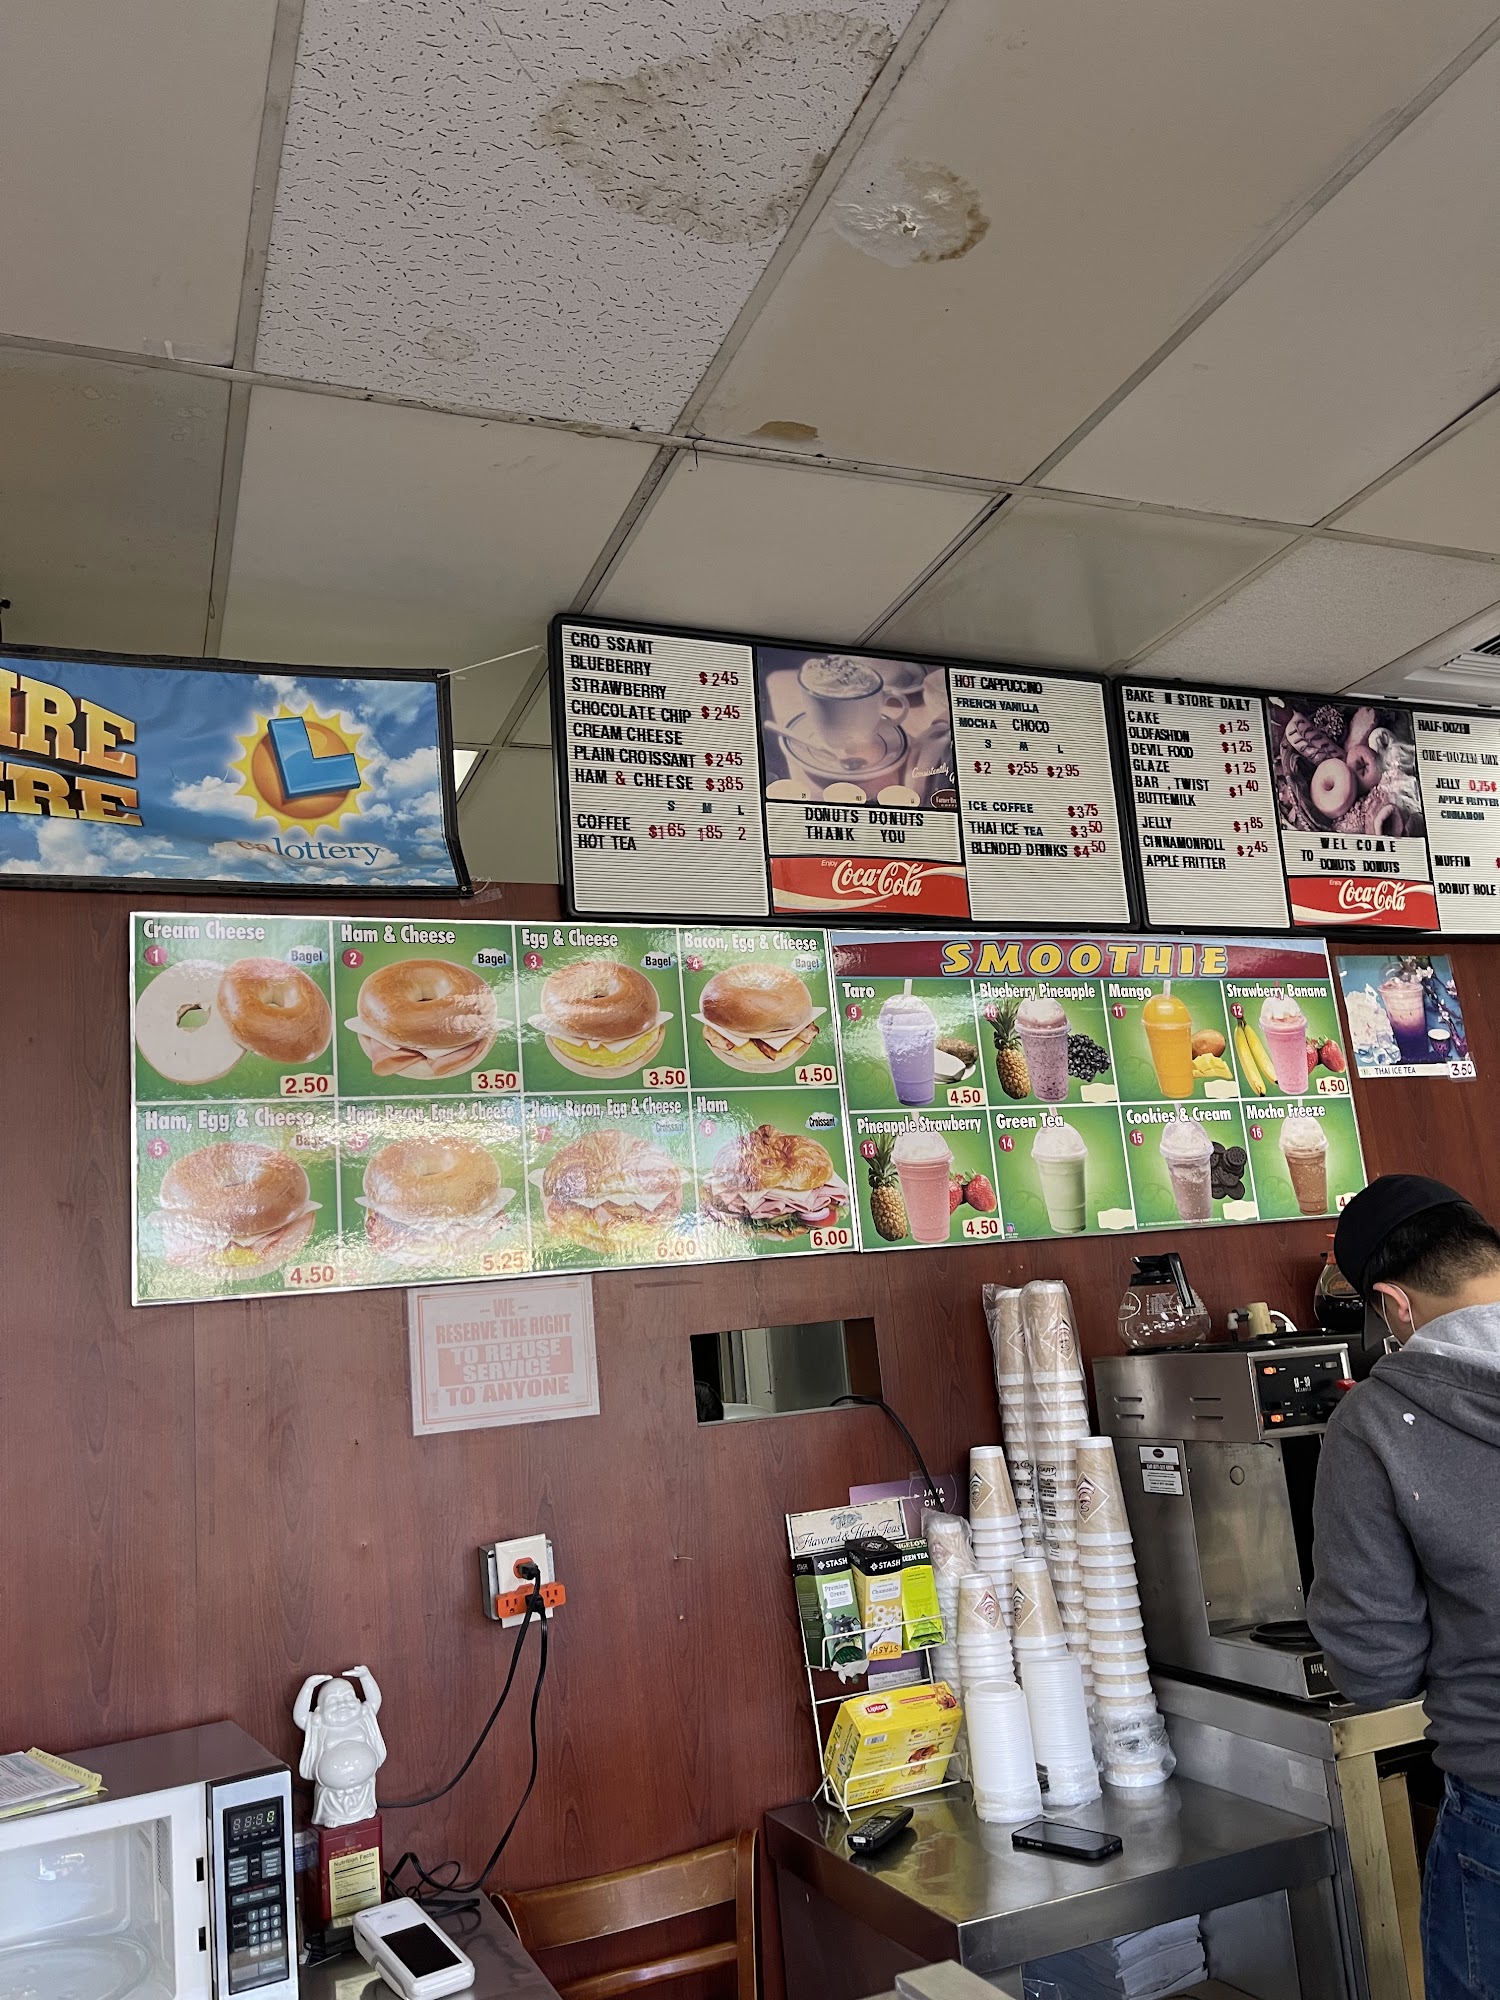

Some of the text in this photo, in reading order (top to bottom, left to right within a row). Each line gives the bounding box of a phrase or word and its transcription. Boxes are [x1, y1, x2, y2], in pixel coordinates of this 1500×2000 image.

[570, 632, 654, 655] CRO SSANT
[570, 655, 652, 677] BLUEBERRY
[571, 677, 667, 700] STRAWBERRY
[955, 675, 1043, 695] HOT CAPPUCCINO
[956, 697, 1040, 714] FRENCH VANILLA
[1125, 689, 1154, 703] BAKE
[1178, 693, 1214, 708] STORE
[1220, 697, 1251, 711] DAILY
[571, 700, 692, 724] CHOCOLATE CHIP
[1127, 711, 1160, 724] CAKE
[959, 717, 1050, 733] MOCHA CHOCO
[1418, 720, 1470, 734] HALF-DOZEN
[572, 723, 683, 746] CREAM CHEESE
[1128, 727, 1190, 742] OLDFASHION
[573, 745, 696, 768] PLAIN CROISSANT
[1131, 743, 1194, 759] DEVIL FOOD
[1133, 759, 1170, 773] GLAZE
[575, 768, 694, 791] HAM & CHEESE
[968, 800, 988, 811] ICE
[992, 801, 1034, 813] COFFEE
[1138, 792, 1196, 806] BUTTEMILK
[577, 814, 631, 832] COFFEE
[805, 807, 924, 827] DONUTS DONUTS
[1142, 816, 1172, 829] JELLY
[1440, 810, 1485, 820] CINNAMON
[805, 826, 906, 844] THANK YOU
[968, 821, 1043, 837] THAI ICE TEA
[578, 834, 637, 851] HOT TEA
[971, 841, 1068, 857] BLENDED DRINKS
[821, 859, 838, 868] Enjoy
[1146, 854, 1226, 869] APPLE FRITTER
[1301, 849, 1314, 861] TO
[1435, 855, 1471, 867] MUFFIN
[1320, 858, 1400, 873] DONUTS DONUTS
[831, 859, 923, 897] Coca-Cola
[1338, 879, 1406, 911] Coca-Cola
[1438, 883, 1497, 896] DONUT HOLE
[143, 919, 266, 941] Cream Cheese
[341, 924, 456, 944] Ham & Cheese
[521, 929, 618, 949] Egg & Cheese
[684, 932, 817, 952] Bacon, Egg & Cheese
[290, 949, 323, 964] Bagel
[477, 952, 507, 967] Bagel
[645, 955, 672, 968] Bagel
[795, 957, 820, 970] Bagel
[942, 942, 1228, 975] SMOOTHIE
[842, 983, 875, 998] Taro
[980, 983, 1096, 1001] Blueberry Pineapple
[1109, 983, 1151, 1001] Mango
[1227, 984, 1327, 1001] Strawberry Banana
[649, 1070, 685, 1086] 3.50
[799, 1067, 833, 1082] 4.50
[1374, 1067, 1390, 1075] THAI
[1392, 1067, 1401, 1075] ICE
[1451, 1063, 1473, 1076] 3.50
[285, 1076, 328, 1095] 2.50
[477, 1072, 517, 1090] 3.50
[1319, 1078, 1345, 1093] 4.50
[696, 1096, 728, 1113] Ham
[950, 1090, 981, 1104] 4.50
[564, 1099, 604, 1119] Bacon,
[606, 1097, 628, 1119] Egg
[631, 1097, 640, 1115] &
[642, 1095, 681, 1115] Cheese
[1126, 1107, 1231, 1124] Cookies & Cream
[1247, 1103, 1325, 1120] Mocha Freeze
[144, 1106, 315, 1133] Ham, Egg & Cheese
[655, 1121, 684, 1133] Croissant
[808, 1115, 836, 1128] Croissant
[857, 1117, 981, 1136] Pineapple Strawberry
[996, 1113, 1064, 1129] Green Tea
[966, 1220, 998, 1234] 4.50
[813, 1230, 848, 1246] 6.00
[656, 1240, 696, 1257] 6.00
[483, 1252, 524, 1271] 5.25
[289, 1266, 334, 1285] 4.50
[493, 1299, 515, 1317] WE
[436, 1314, 571, 1344] RESERVE THE RIGHT
[451, 1338, 561, 1365] TO REFUSE
[462, 1357, 551, 1383] SERVICE
[446, 1386, 475, 1406] TO
[482, 1376, 569, 1403] ANYONE
[796, 1533, 840, 1551] Flavored
[842, 1531, 849, 1540] &
[876, 1519, 901, 1538] Teas
[825, 1557, 848, 1569] STASH
[878, 1559, 901, 1571] STASH
[824, 1583, 849, 1592] Premium
[829, 1590, 847, 1598] Green
[871, 1586, 899, 1595] Chamomile
[867, 1704, 886, 1714] Lipton
[333, 1856, 359, 1868] Nutrition
[359, 1851, 375, 1861] Facts
